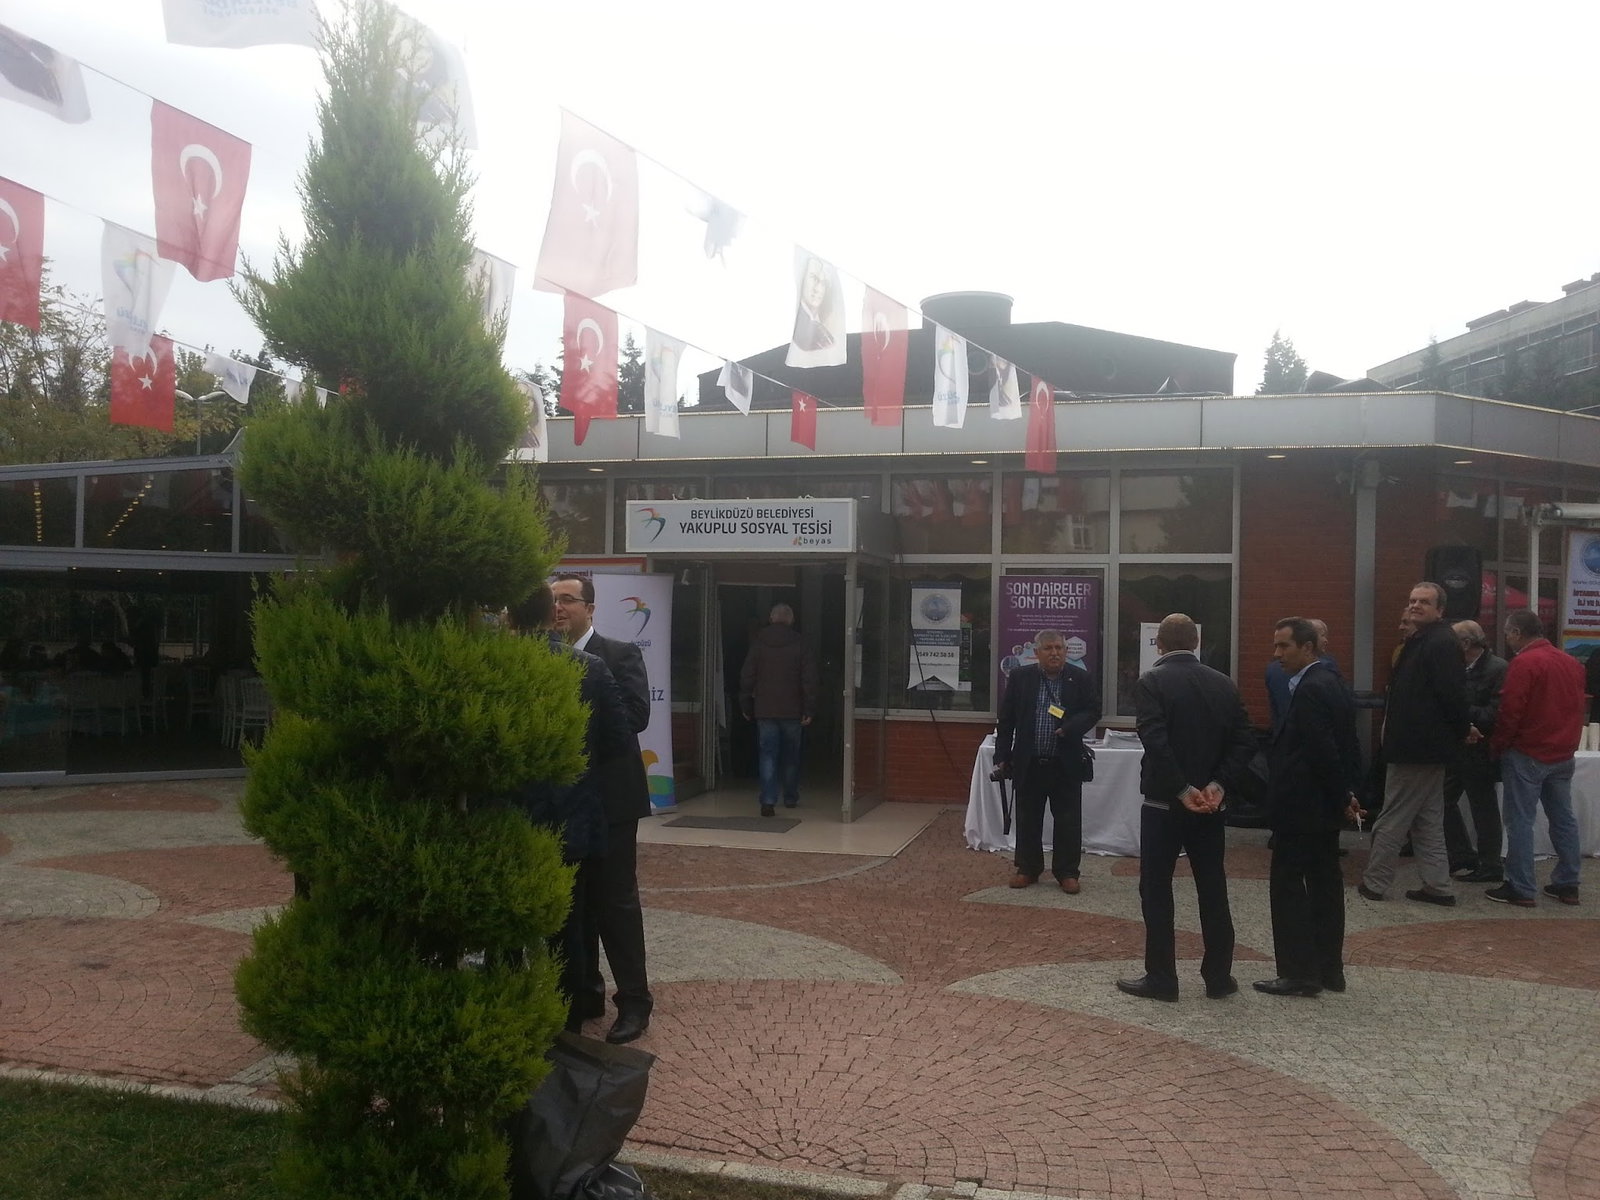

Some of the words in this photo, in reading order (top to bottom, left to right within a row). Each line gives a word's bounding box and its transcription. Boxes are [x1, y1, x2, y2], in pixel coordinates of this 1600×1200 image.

[690, 508, 754, 520] BEYLİKDÜZÜ
[756, 506, 814, 519] BELEDİYESİ
[679, 521, 737, 534] YAKUPLU
[740, 521, 789, 535] SOSYAL
[792, 519, 832, 535] TESİSİ
[803, 536, 832, 546] beyas
[1006, 582, 1030, 596] SON
[1033, 581, 1092, 597] DAİRELER
[1010, 596, 1036, 609] SON
[1038, 596, 1088, 610] FIRSAT!
